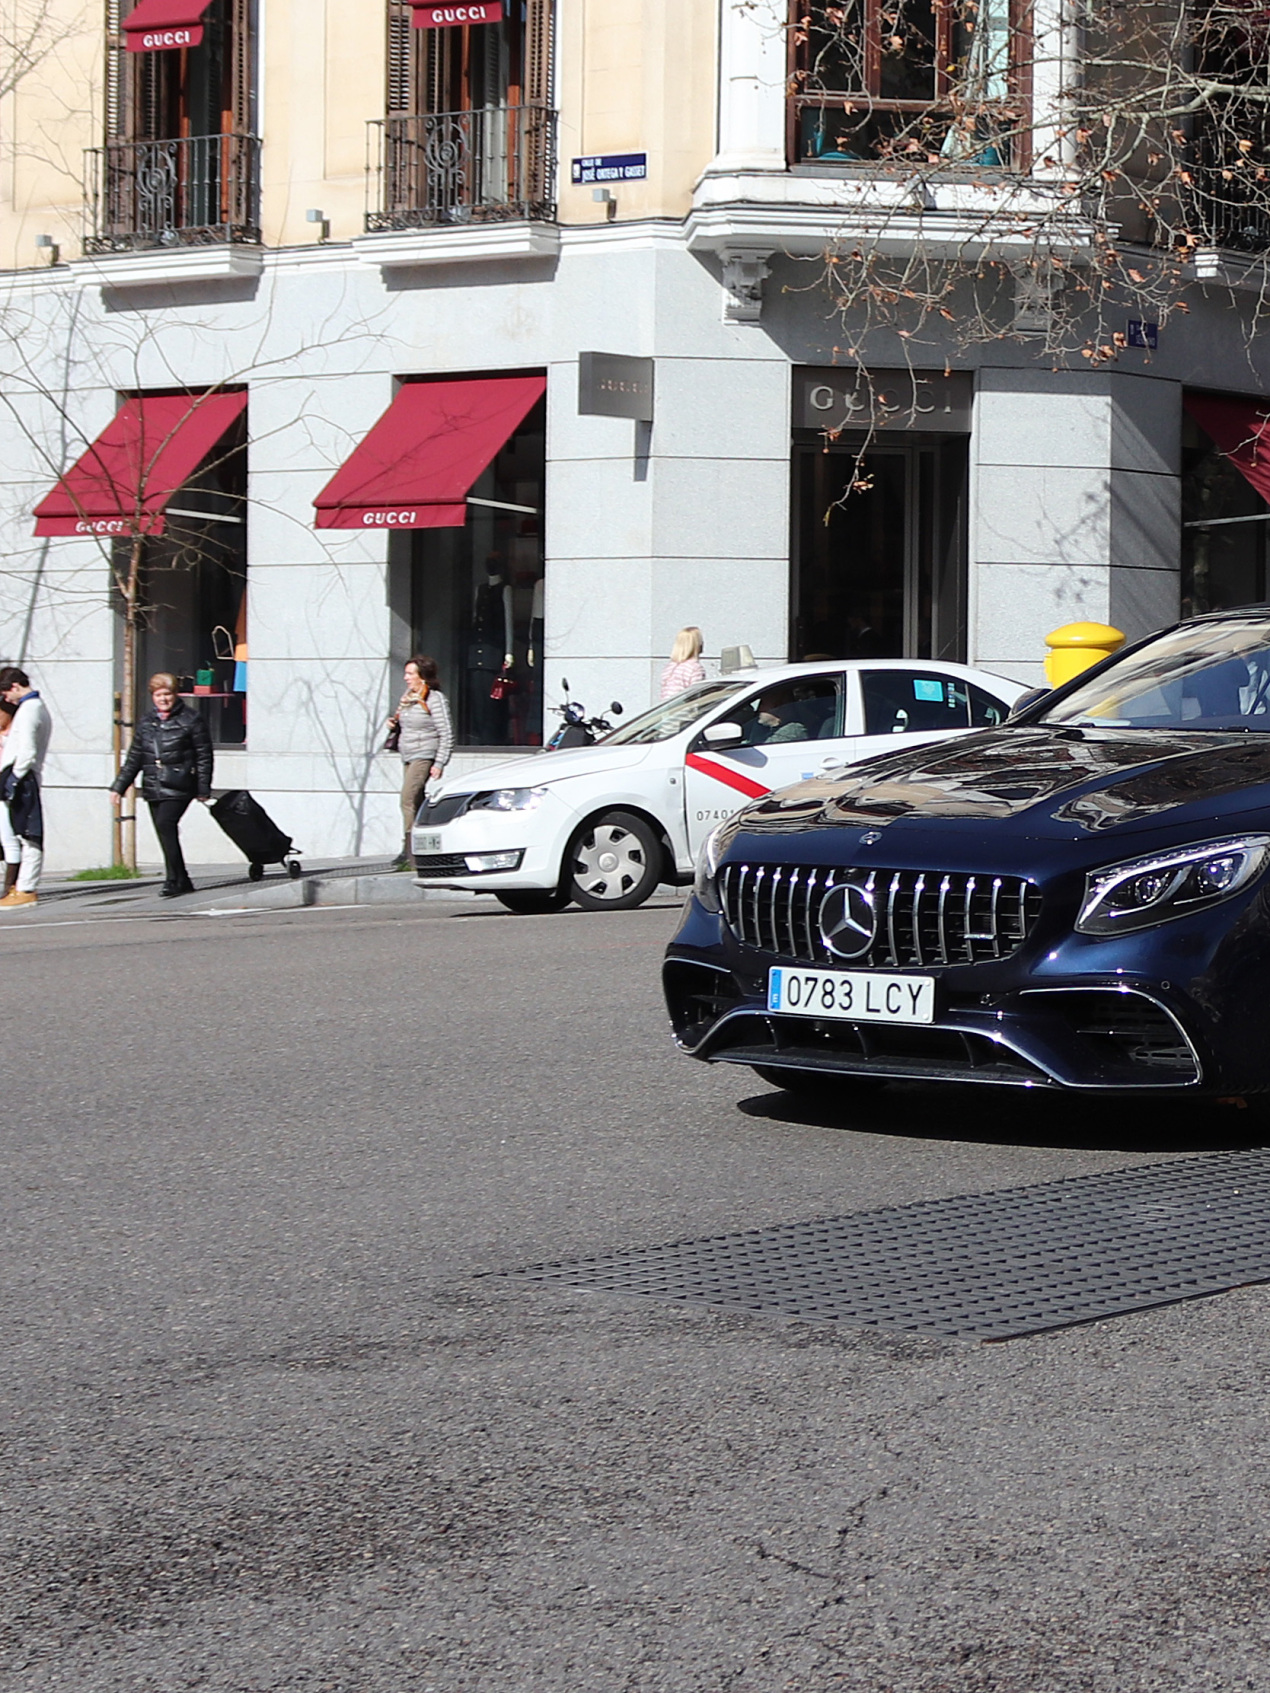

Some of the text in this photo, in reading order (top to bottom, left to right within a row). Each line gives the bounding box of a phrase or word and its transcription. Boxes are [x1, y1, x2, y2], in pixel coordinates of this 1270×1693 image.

[432, 6, 486, 23] GUCCI
[142, 30, 190, 48] GUCCI
[74, 520, 124, 532] GUCCI
[362, 511, 417, 525] GUCCI
[787, 975, 854, 1011] 0783
[866, 981, 924, 1016] LCY
